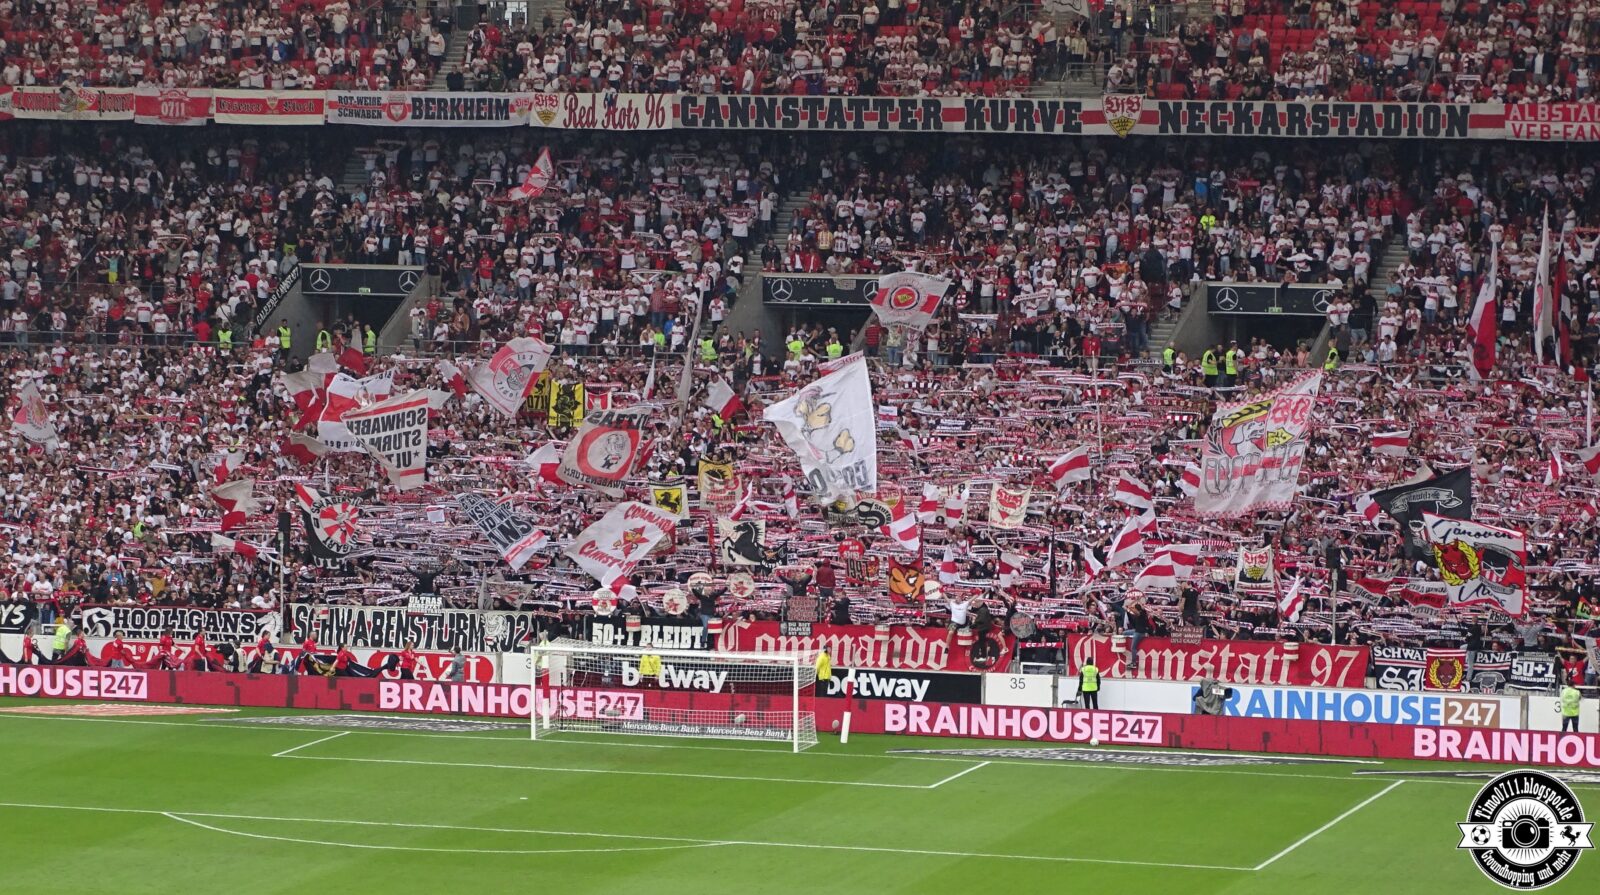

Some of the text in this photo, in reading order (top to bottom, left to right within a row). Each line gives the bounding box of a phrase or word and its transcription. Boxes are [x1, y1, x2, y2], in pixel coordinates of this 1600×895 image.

[161, 101, 185, 117] 0711
[337, 107, 382, 119] SCHWABEN
[411, 97, 510, 120] BERKHEIM
[563, 92, 667, 130] Red Hots 96
[681, 96, 1082, 133] CANNSTATTER KURVE
[1159, 101, 1469, 137] NECKARSTADION
[409, 596, 442, 604] ULTRAS
[112, 608, 255, 634] HOOLIGANS
[294, 605, 529, 652] SCHWABENSTURM 02
[592, 622, 634, 646] 50+1
[717, 620, 949, 672] Commando
[1074, 632, 1294, 687] Cannstatt
[1311, 649, 1359, 688] 97
[1511, 661, 1556, 678] 50+1
[621, 661, 728, 694] btway
[1010, 678, 1026, 690] 35
[706, 726, 786, 738] Mercedes-Benz Bank
